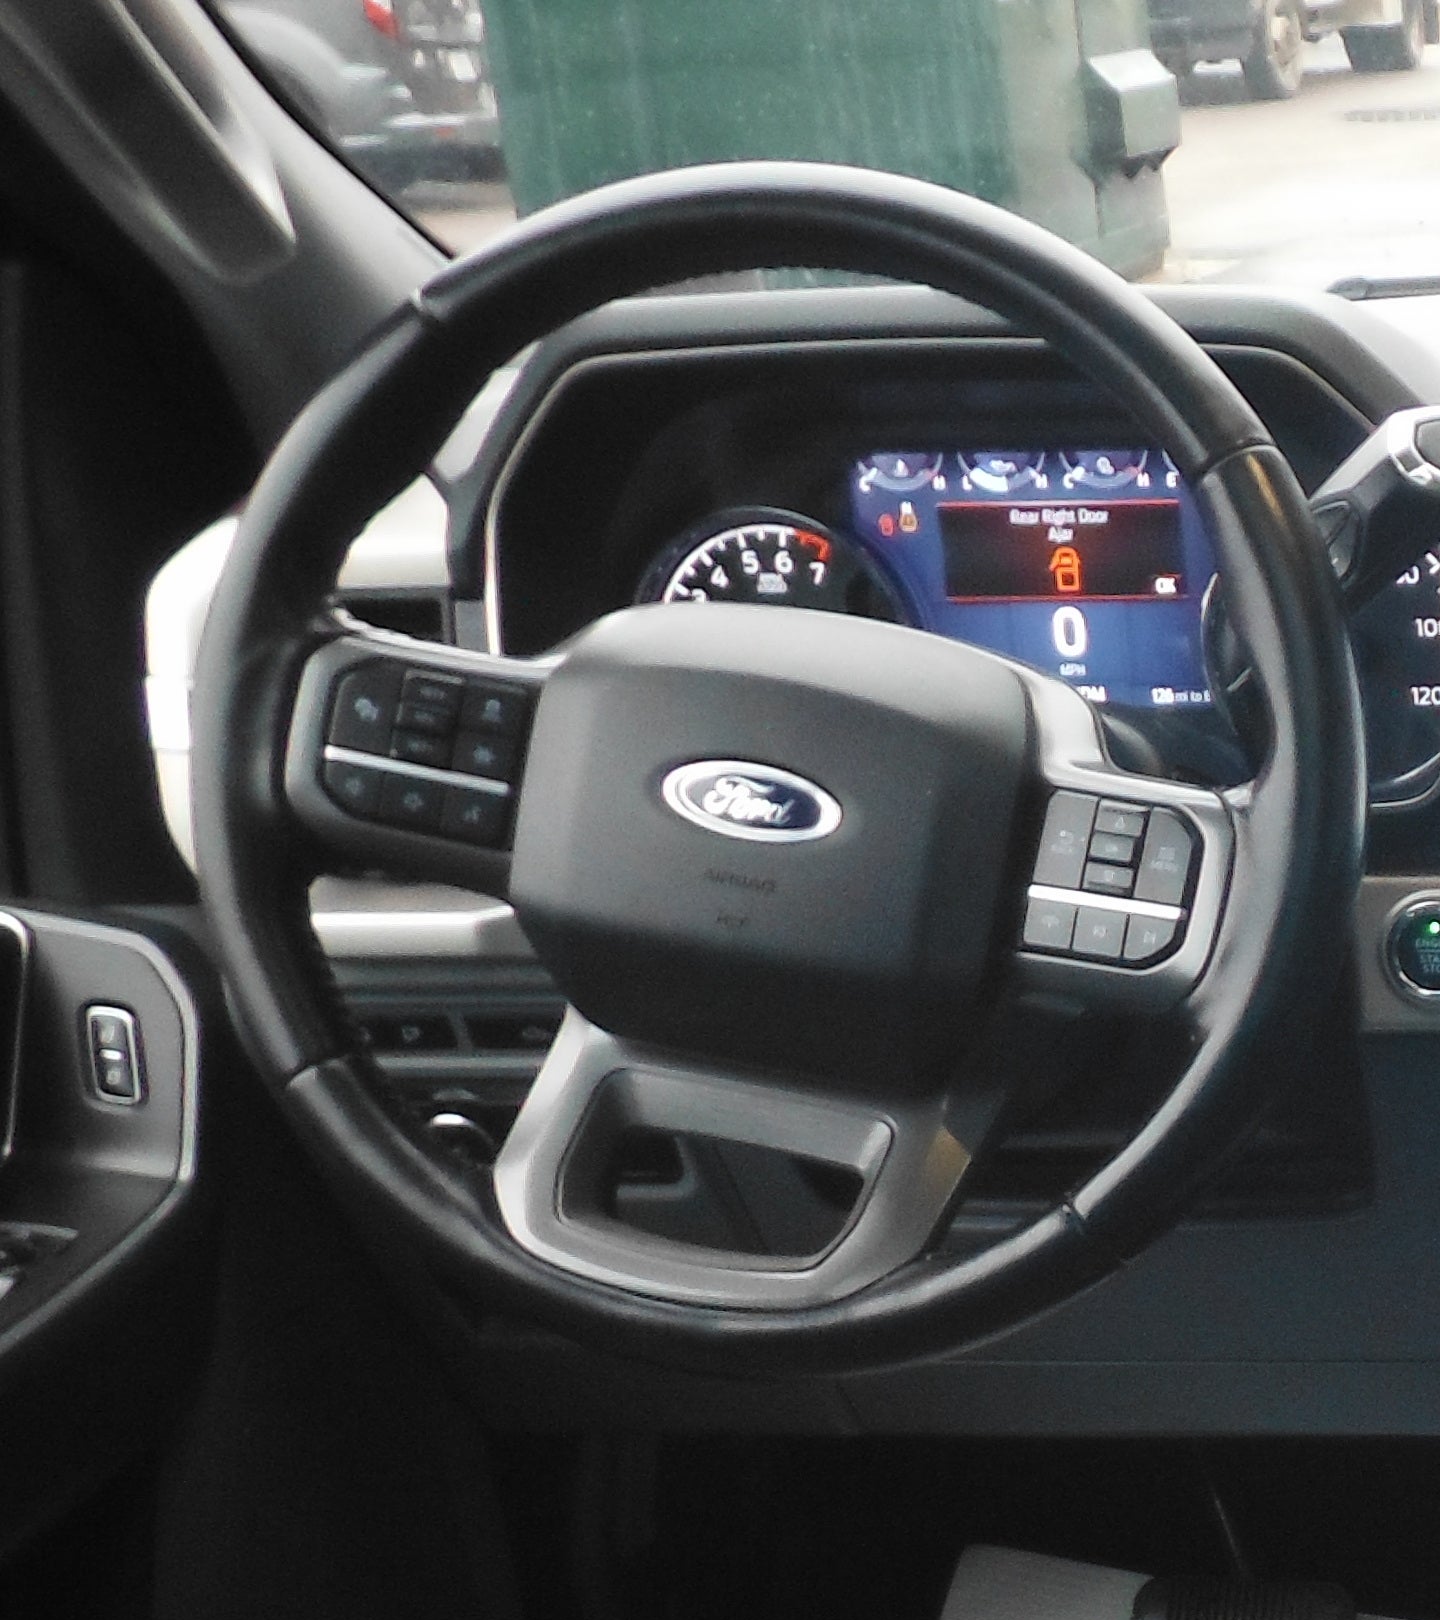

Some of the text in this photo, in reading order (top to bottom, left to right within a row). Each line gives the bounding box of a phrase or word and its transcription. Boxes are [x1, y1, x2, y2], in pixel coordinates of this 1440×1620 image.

[741, 549, 759, 575] 5
[774, 550, 793, 574] 6
[809, 561, 826, 585] 7
[710, 566, 729, 588] 4
[1053, 605, 1089, 658] 0
[703, 773, 796, 825] Ford
